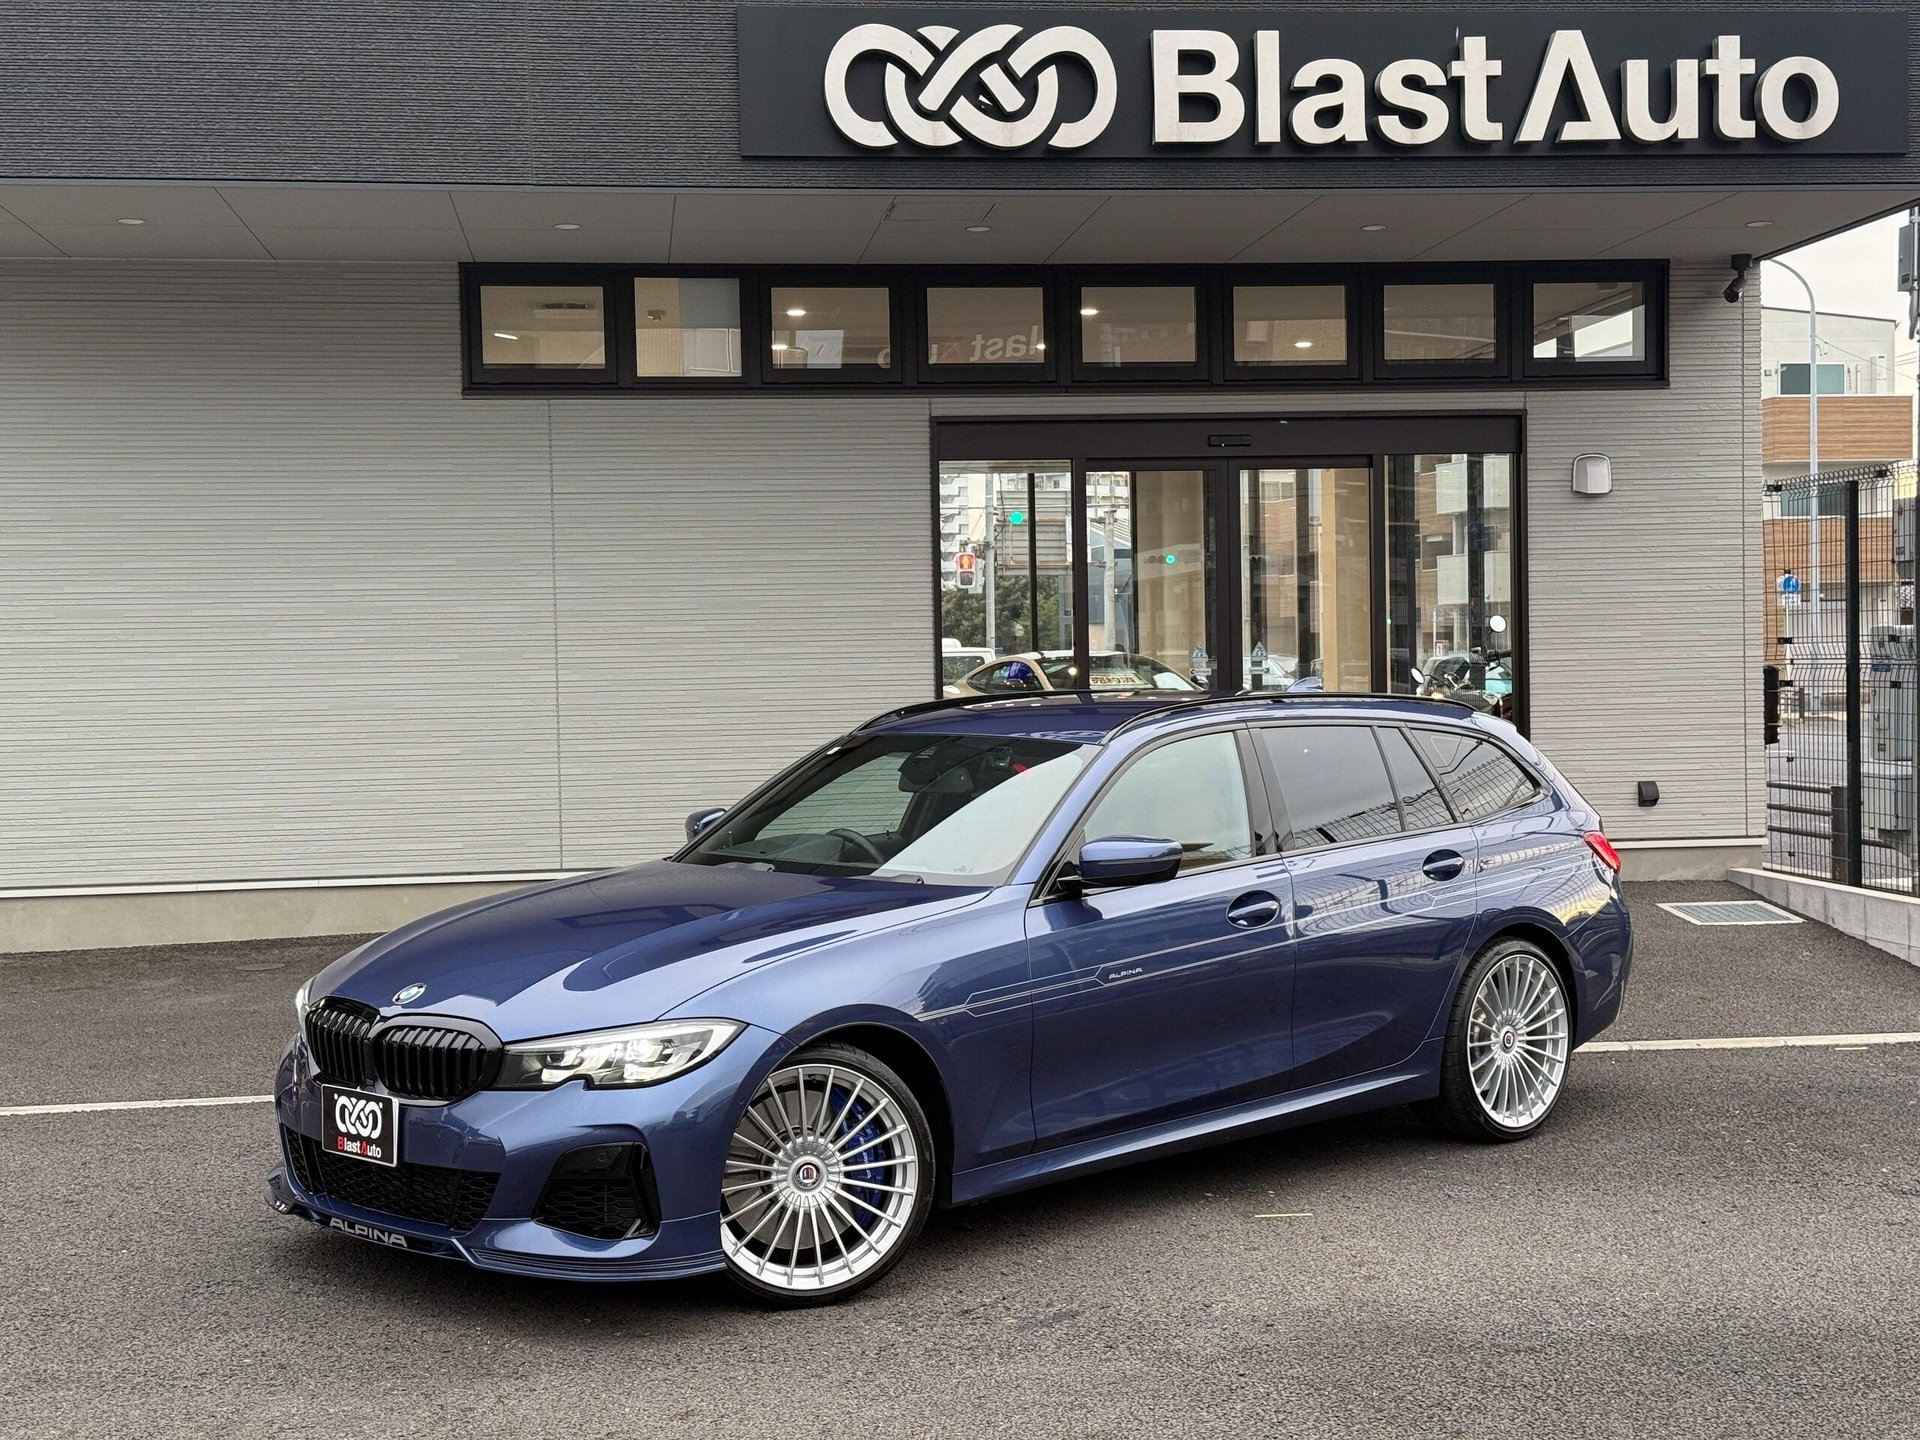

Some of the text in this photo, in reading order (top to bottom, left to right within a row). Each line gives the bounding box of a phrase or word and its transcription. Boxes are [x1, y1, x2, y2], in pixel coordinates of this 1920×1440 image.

[1151, 30, 1841, 146] Blast Auto
[1108, 967, 1143, 980] ALPINA
[329, 1217, 408, 1248] ALPINA
